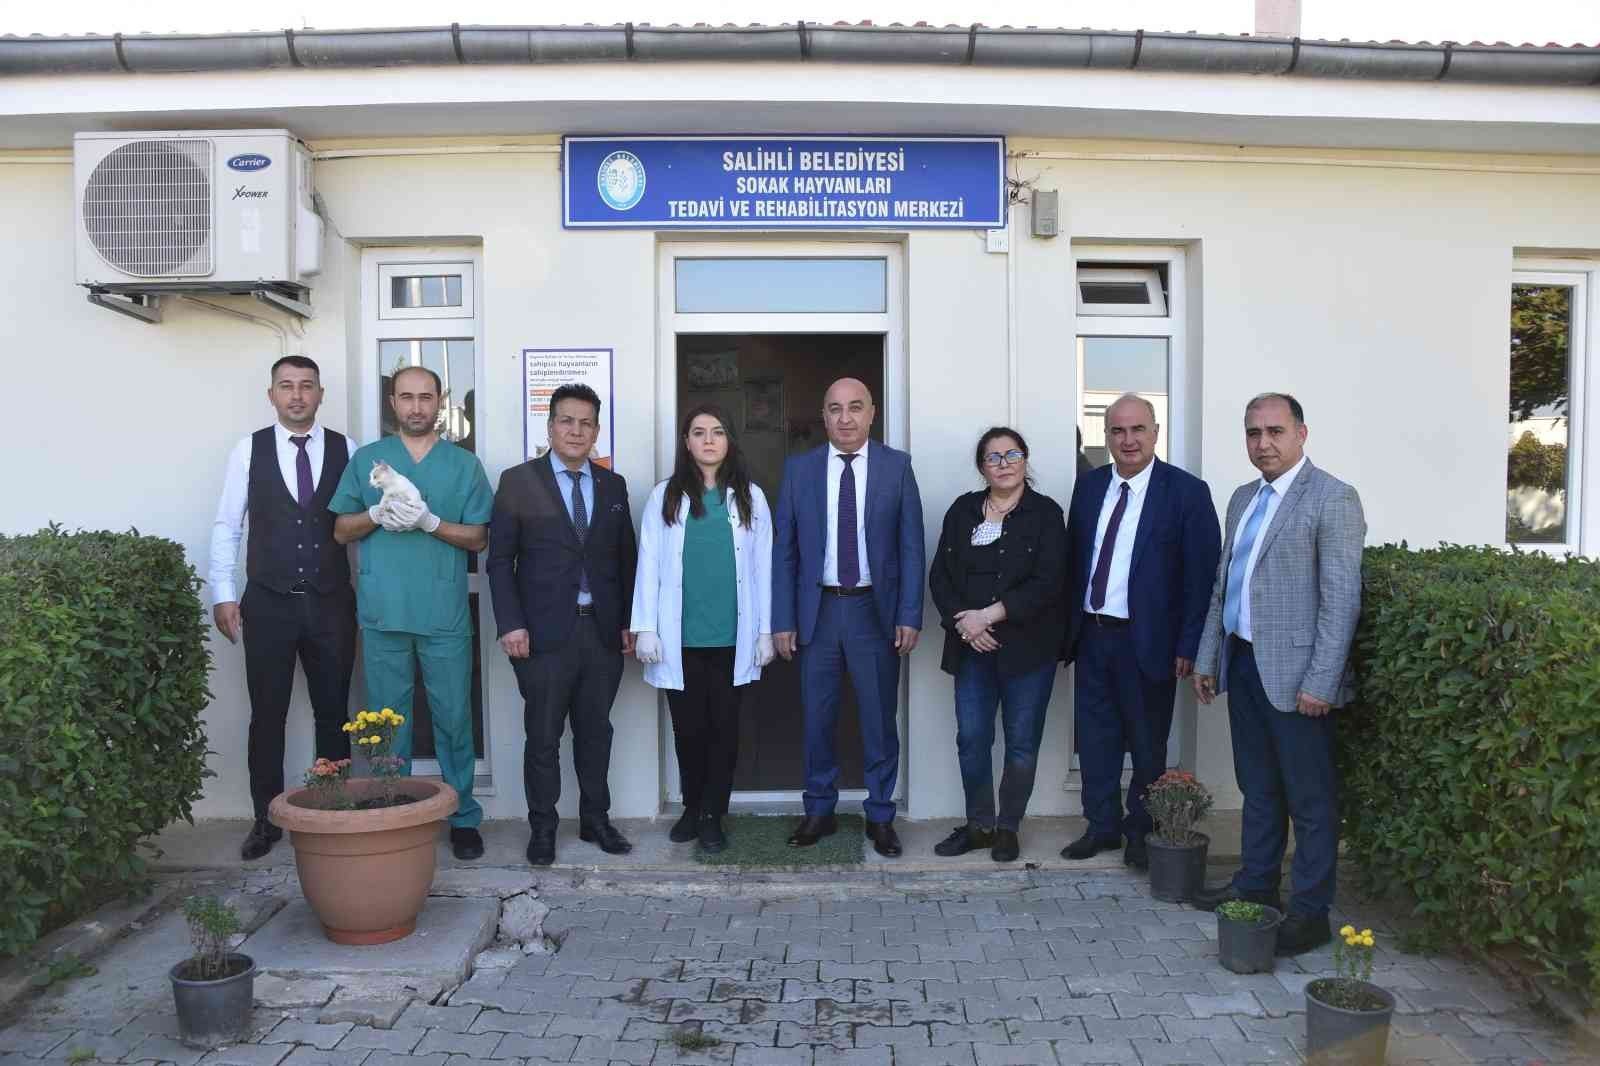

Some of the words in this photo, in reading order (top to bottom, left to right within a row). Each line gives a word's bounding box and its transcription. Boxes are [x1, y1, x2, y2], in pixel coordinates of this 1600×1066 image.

[232, 158, 266, 167] Carrier
[723, 147, 793, 171] SALİHLİ
[799, 147, 905, 172] BELEDİYESİ
[736, 176, 789, 194] SOKAK
[794, 177, 891, 194] HAYVANLARI
[667, 196, 724, 217] TEDAVİ
[729, 200, 750, 217] VE
[755, 196, 889, 218] REHABİLİTASYON
[894, 197, 964, 218] MERKEZİ
